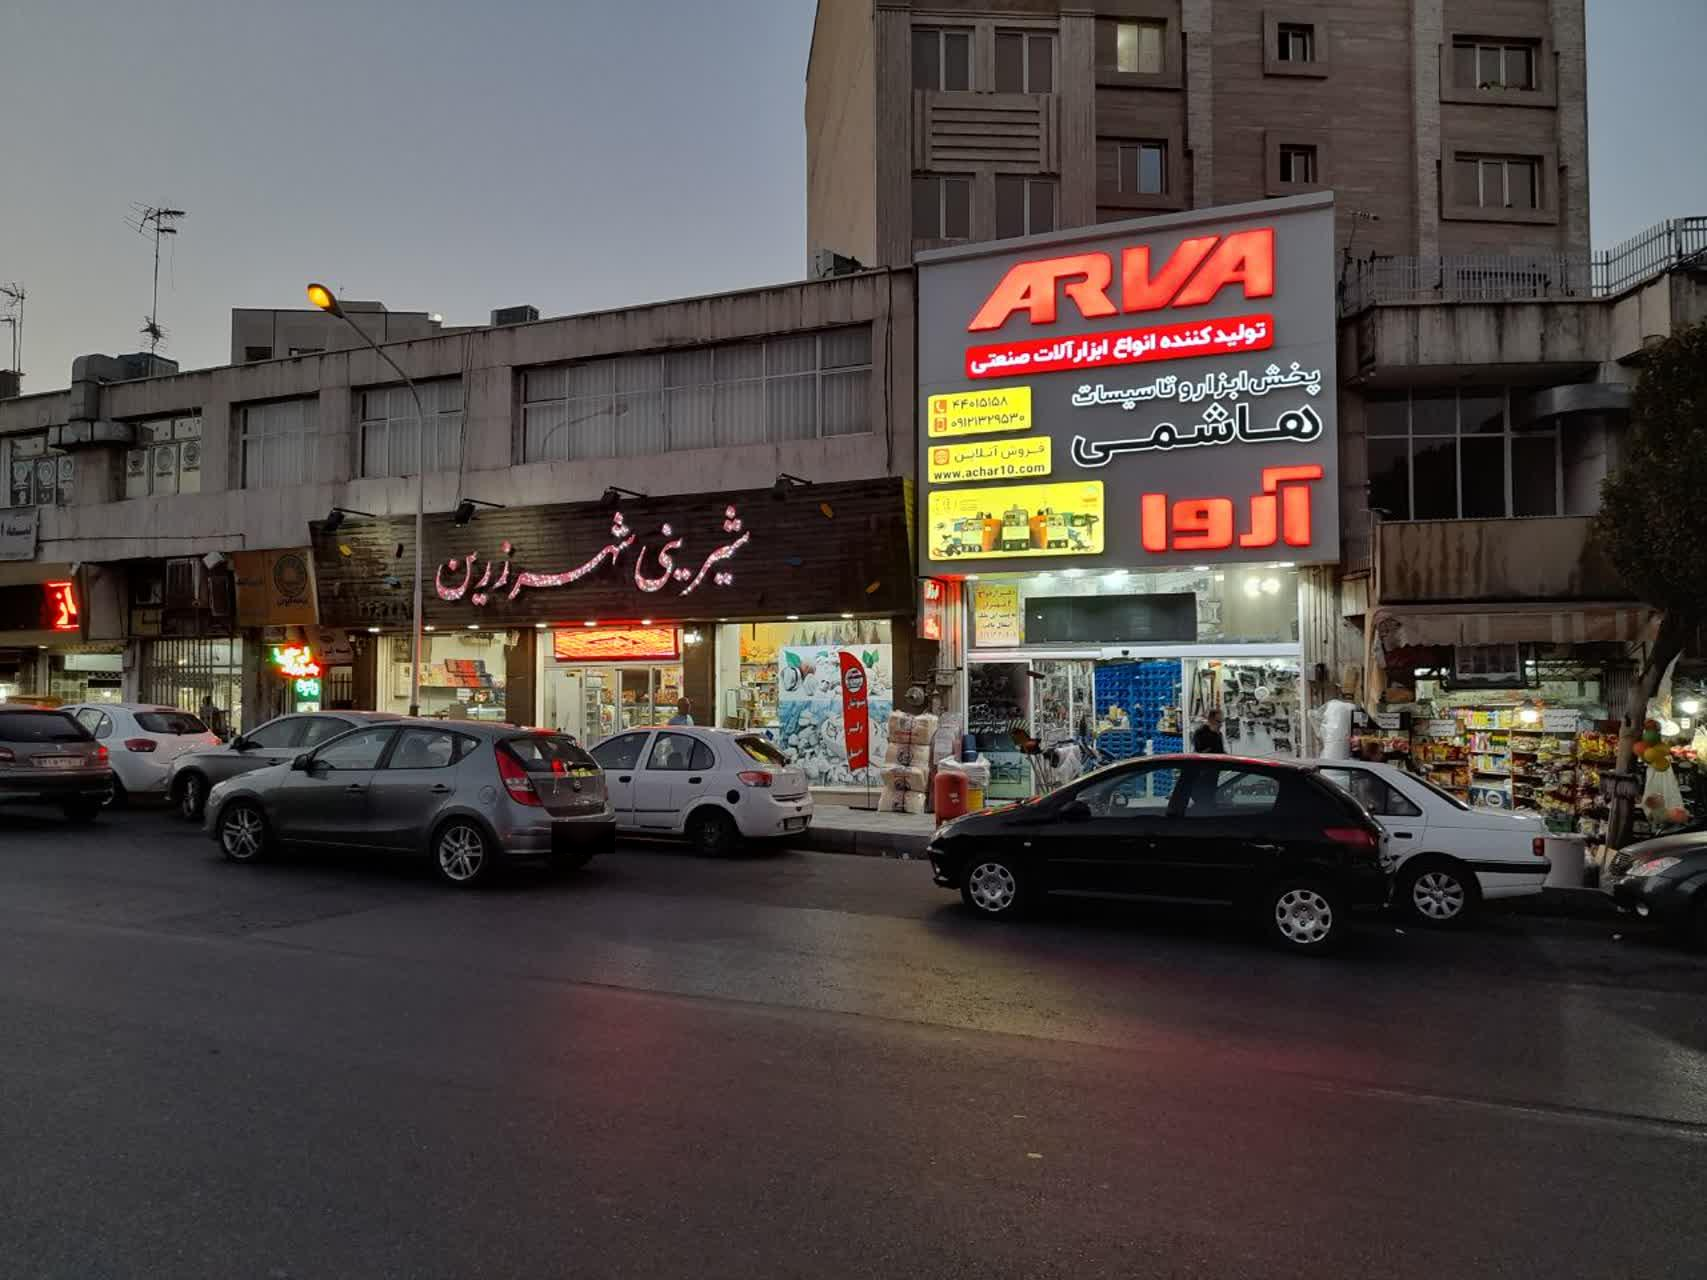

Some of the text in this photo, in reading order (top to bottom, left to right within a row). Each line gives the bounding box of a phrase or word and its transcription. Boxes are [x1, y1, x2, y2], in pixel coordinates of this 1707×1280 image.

[967, 226, 1275, 333] ARVA
[1113, 333, 1156, 359] انواع
[1160, 325, 1213, 350] کننده
[1214, 322, 1266, 347] تولید
[970, 350, 1031, 374] صنعتی
[1249, 361, 1321, 396] پخش
[1072, 375, 1177, 410] تاسیسات
[1071, 400, 1323, 468] هاشمی
[954, 444, 1045, 463] فروش آنلاین
[934, 464, 1045, 479] www.achar10.com
[635, 504, 750, 597] شیرینی
